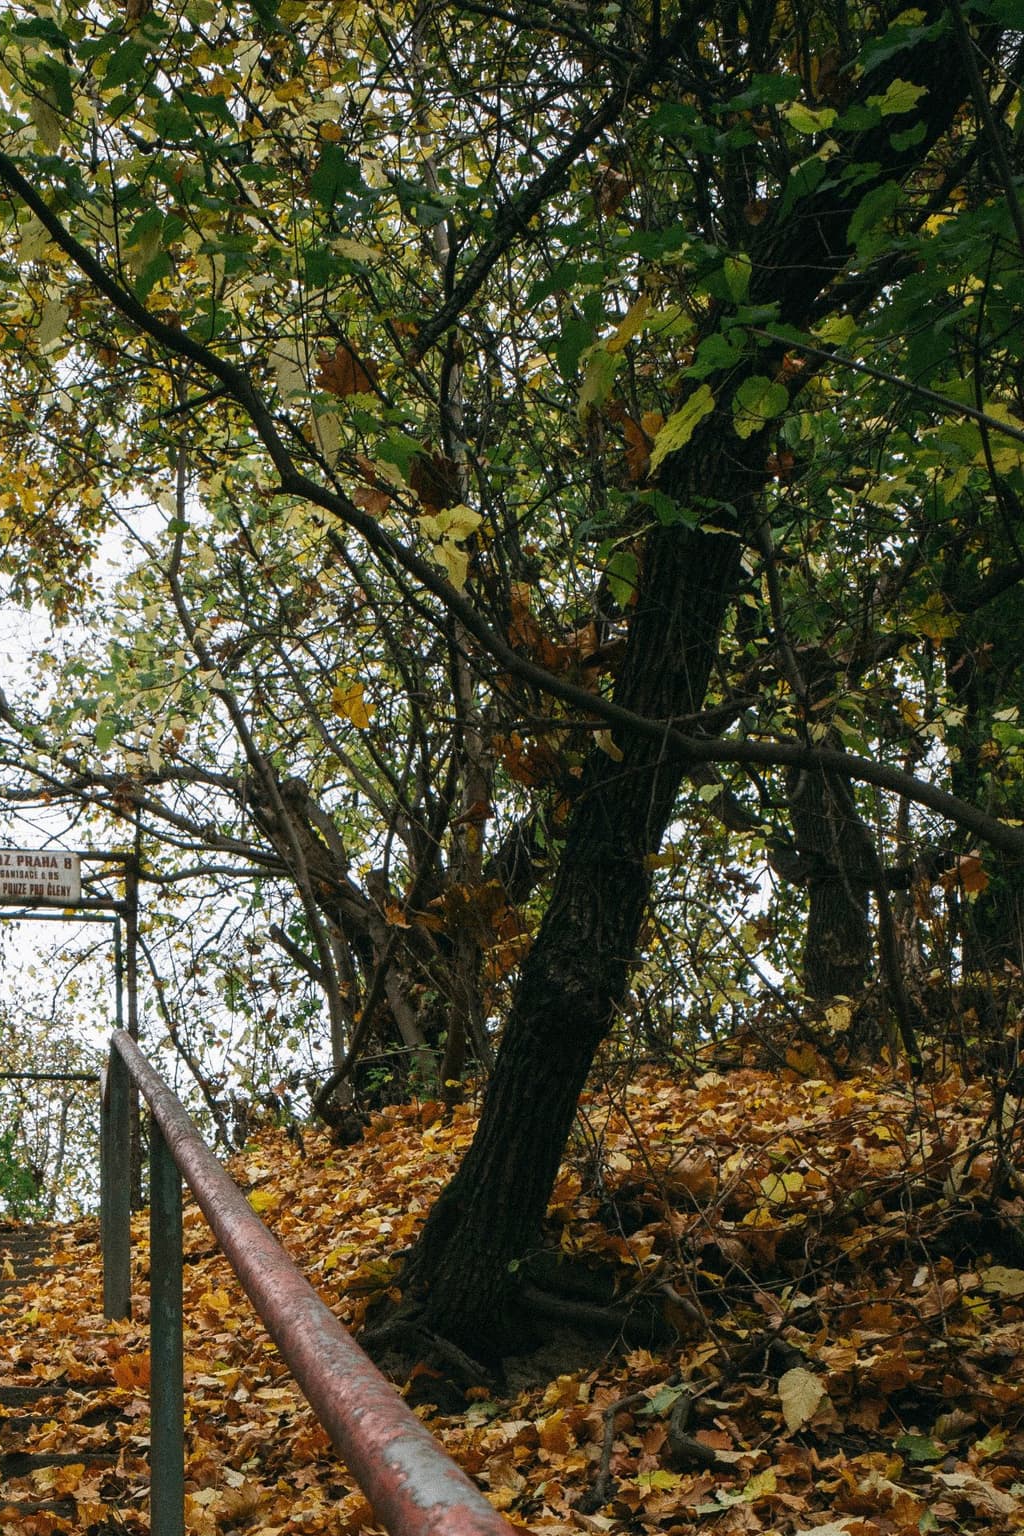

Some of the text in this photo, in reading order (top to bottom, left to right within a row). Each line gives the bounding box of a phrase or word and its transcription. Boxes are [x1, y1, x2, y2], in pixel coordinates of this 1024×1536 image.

[17, 855, 58, 868] PRAHA
[64, 858, 73, 870] 8
[3, 882, 27, 894] POUZE
[30, 884, 44, 895] PRO
[47, 883, 71, 896] ČLENY
